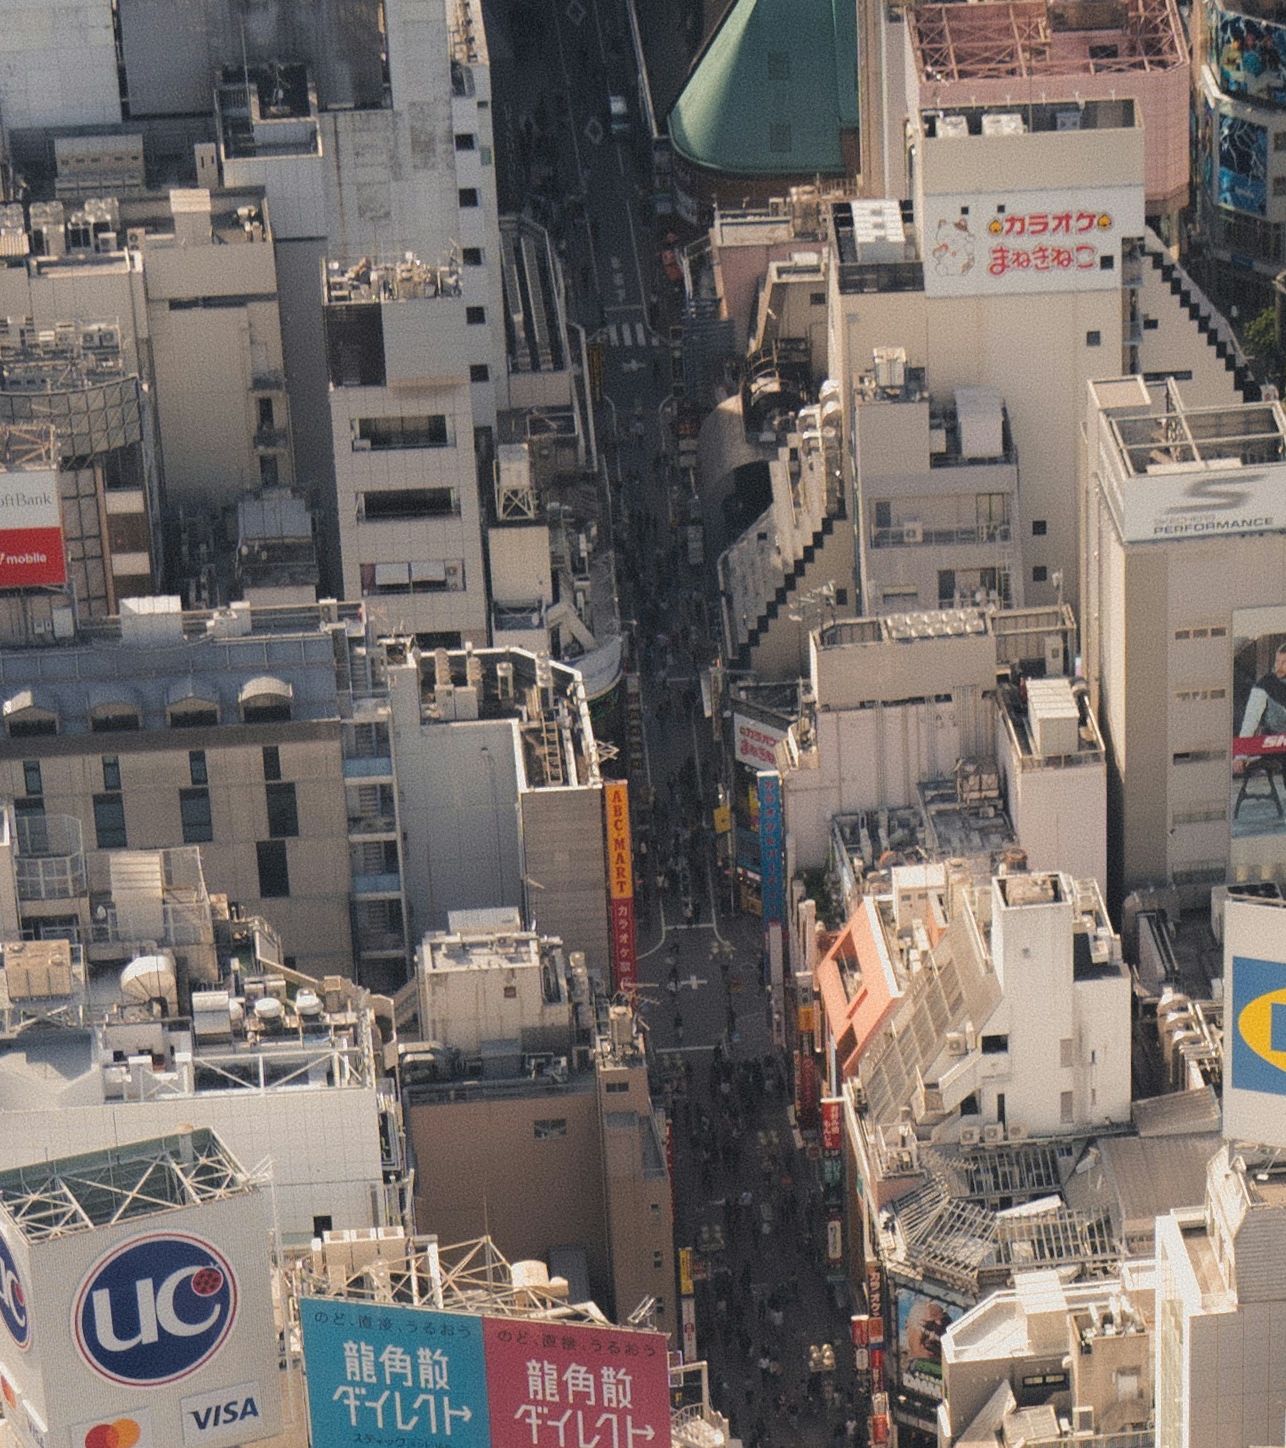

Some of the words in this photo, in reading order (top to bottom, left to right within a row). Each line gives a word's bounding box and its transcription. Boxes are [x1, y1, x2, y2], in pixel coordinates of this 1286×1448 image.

[1004, 212, 1097, 236] カラオケ
[989, 244, 1097, 275] まねきねこ
[1153, 516, 1274, 535] PERFORMANCE
[7, 553, 48, 565] mobile
[91, 1264, 222, 1352] UC
[343, 1339, 451, 1392] 龍角散
[526, 1359, 633, 1411] 龍角散
[190, 1397, 260, 1431] VISA
[331, 1384, 473, 1437] ダイレクト
